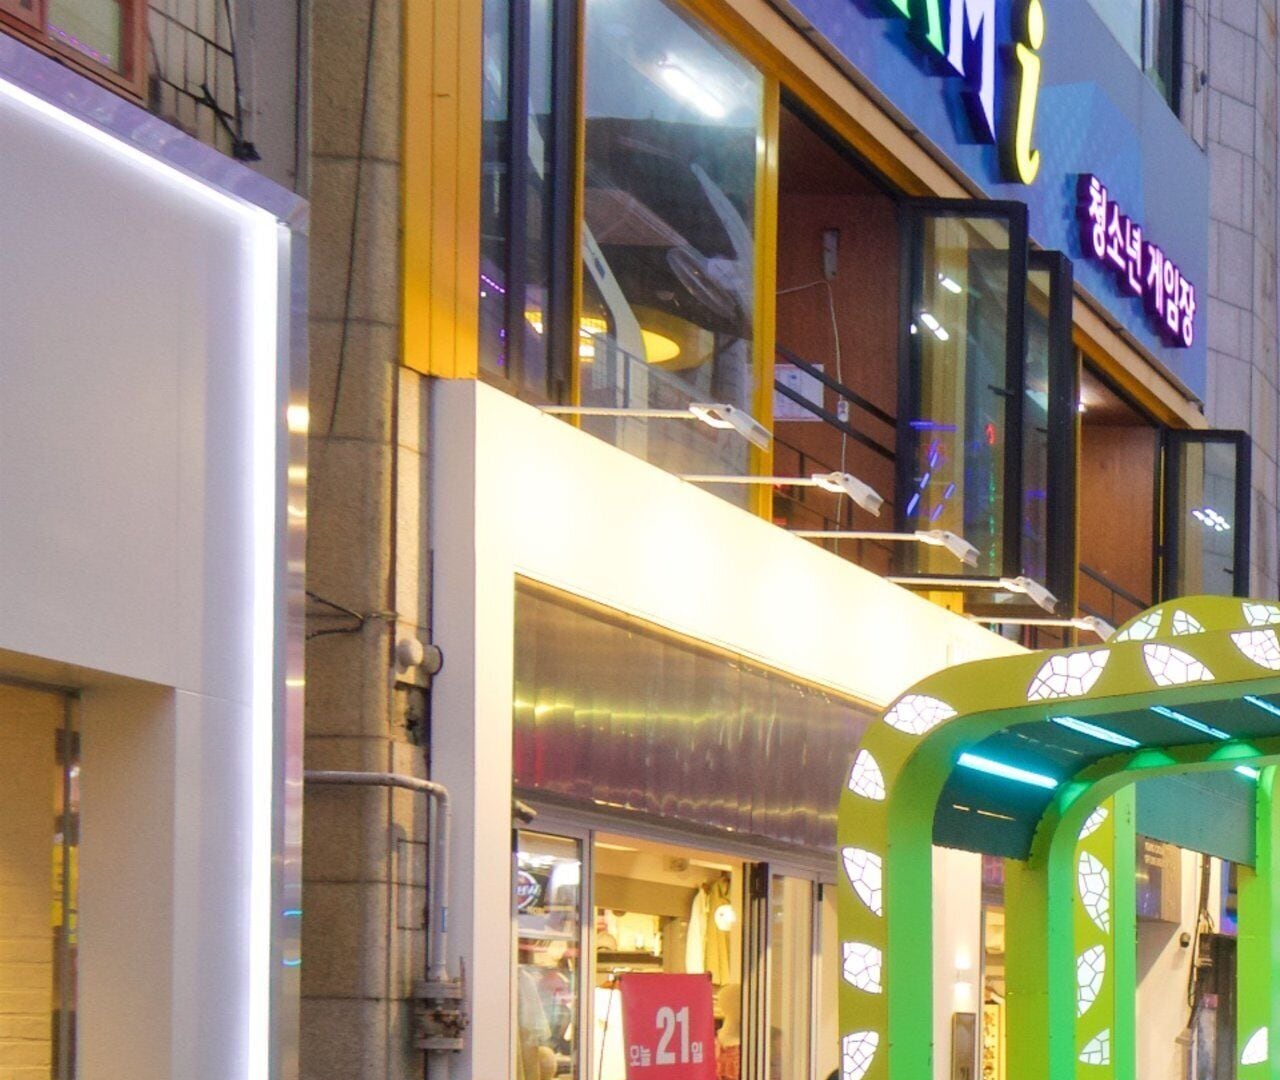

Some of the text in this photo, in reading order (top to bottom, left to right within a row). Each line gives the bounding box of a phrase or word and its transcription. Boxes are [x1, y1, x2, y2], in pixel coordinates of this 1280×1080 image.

[1089, 178, 1196, 347] 청소년 게임장
[630, 1044, 652, 1067] 오늘
